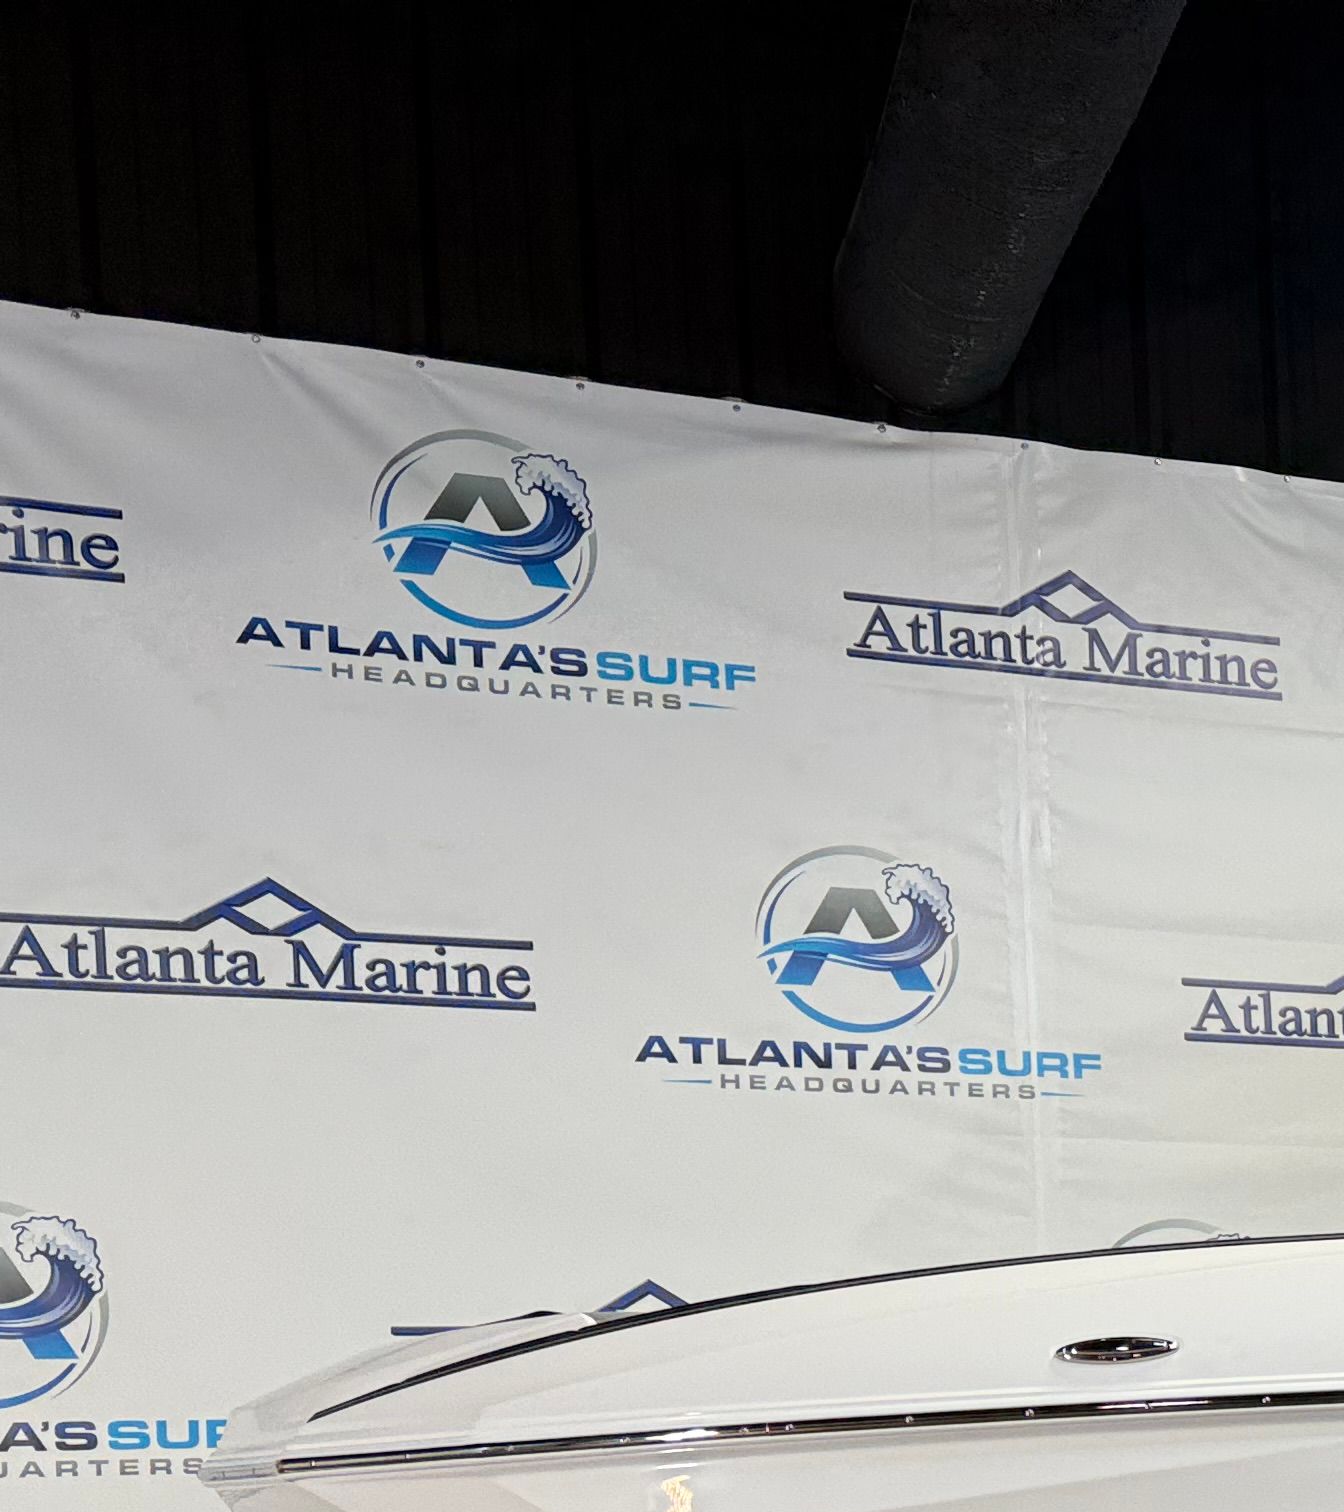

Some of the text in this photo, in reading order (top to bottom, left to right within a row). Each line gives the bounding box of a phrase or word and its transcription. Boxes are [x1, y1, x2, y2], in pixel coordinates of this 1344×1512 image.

[0, 508, 119, 570] ine
[236, 616, 756, 691] ATLANTA'S SURF
[854, 605, 1279, 690] Atlanta Marine
[331, 662, 682, 710] HEADQUARTERS
[0, 925, 532, 1000] Atlanta Marine
[635, 1035, 1101, 1079] ATLANTA'S SURF
[720, 1074, 1036, 1100] HEADQUARTERS
